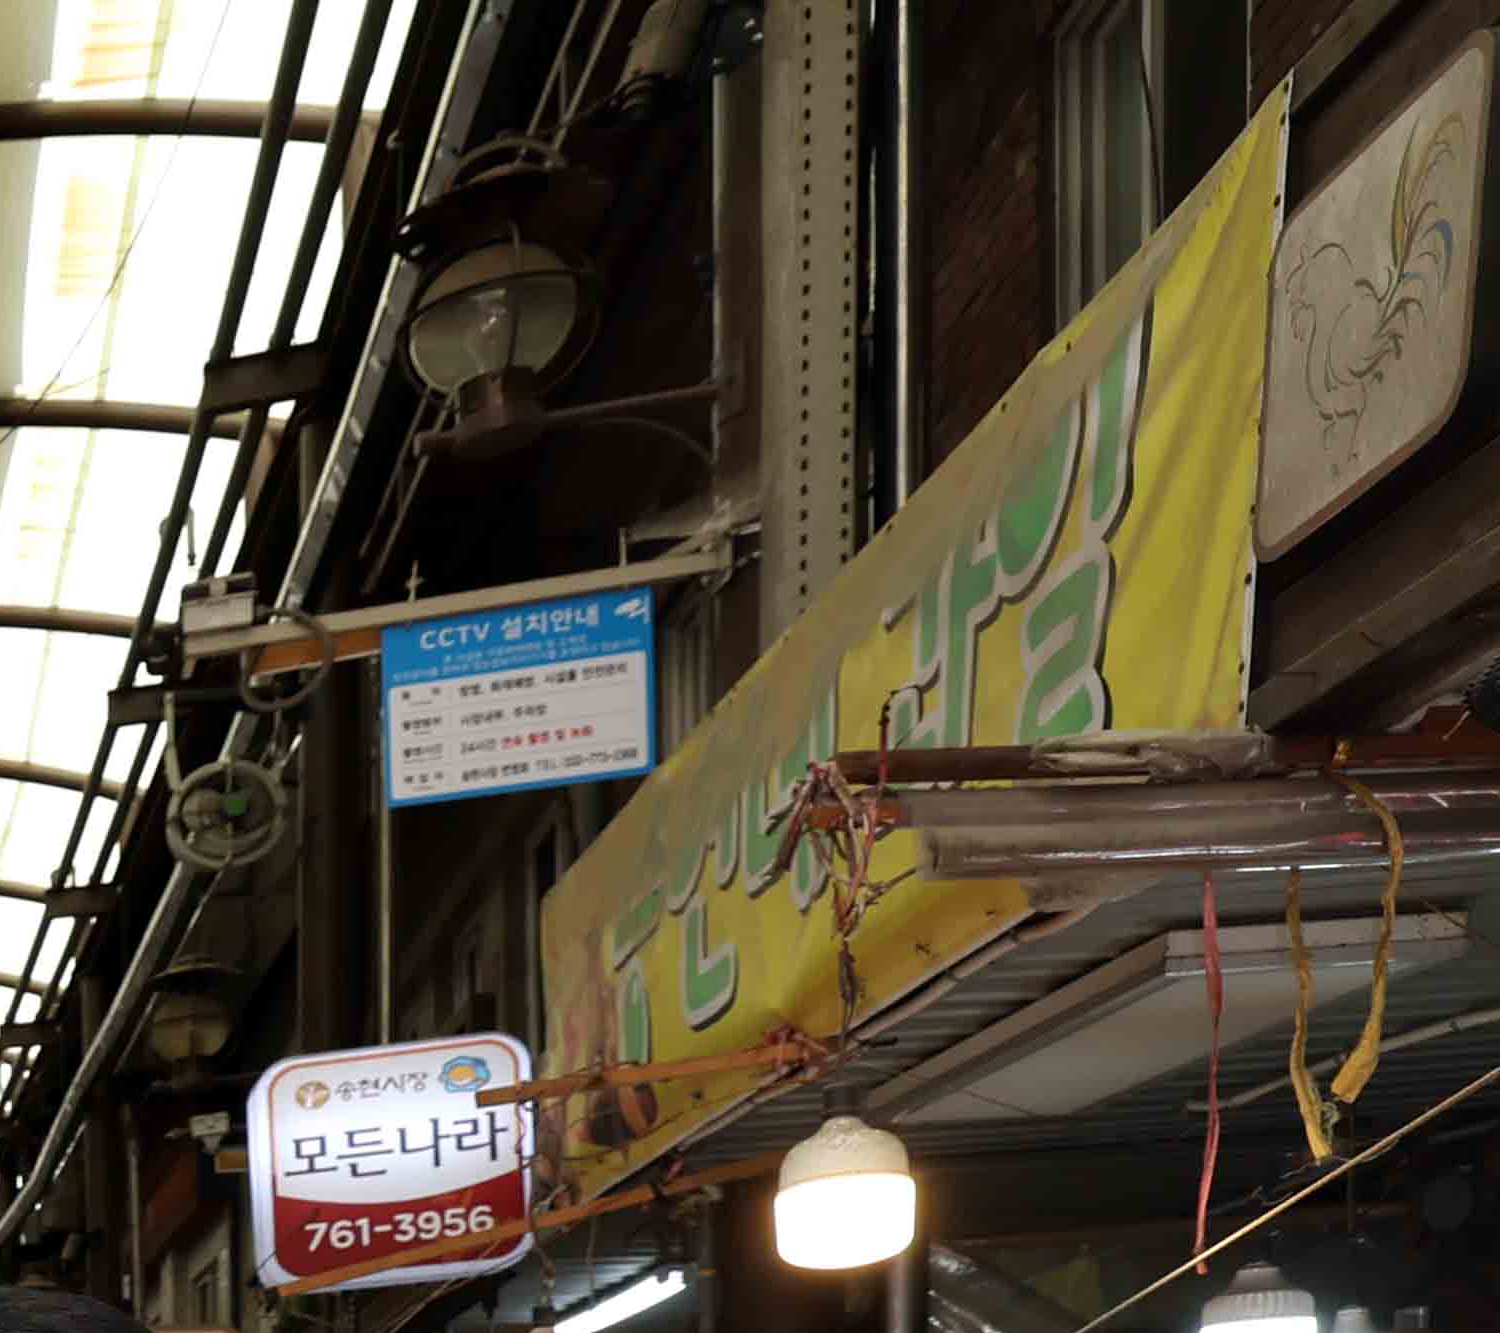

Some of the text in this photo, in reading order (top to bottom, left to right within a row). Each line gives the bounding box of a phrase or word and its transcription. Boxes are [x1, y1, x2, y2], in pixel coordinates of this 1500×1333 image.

[420, 604, 600, 650] CCTV 설치안내
[335, 1068, 429, 1104] 송현시장
[284, 1112, 509, 1179] 모든나라
[304, 1206, 495, 1253] 761-3956
